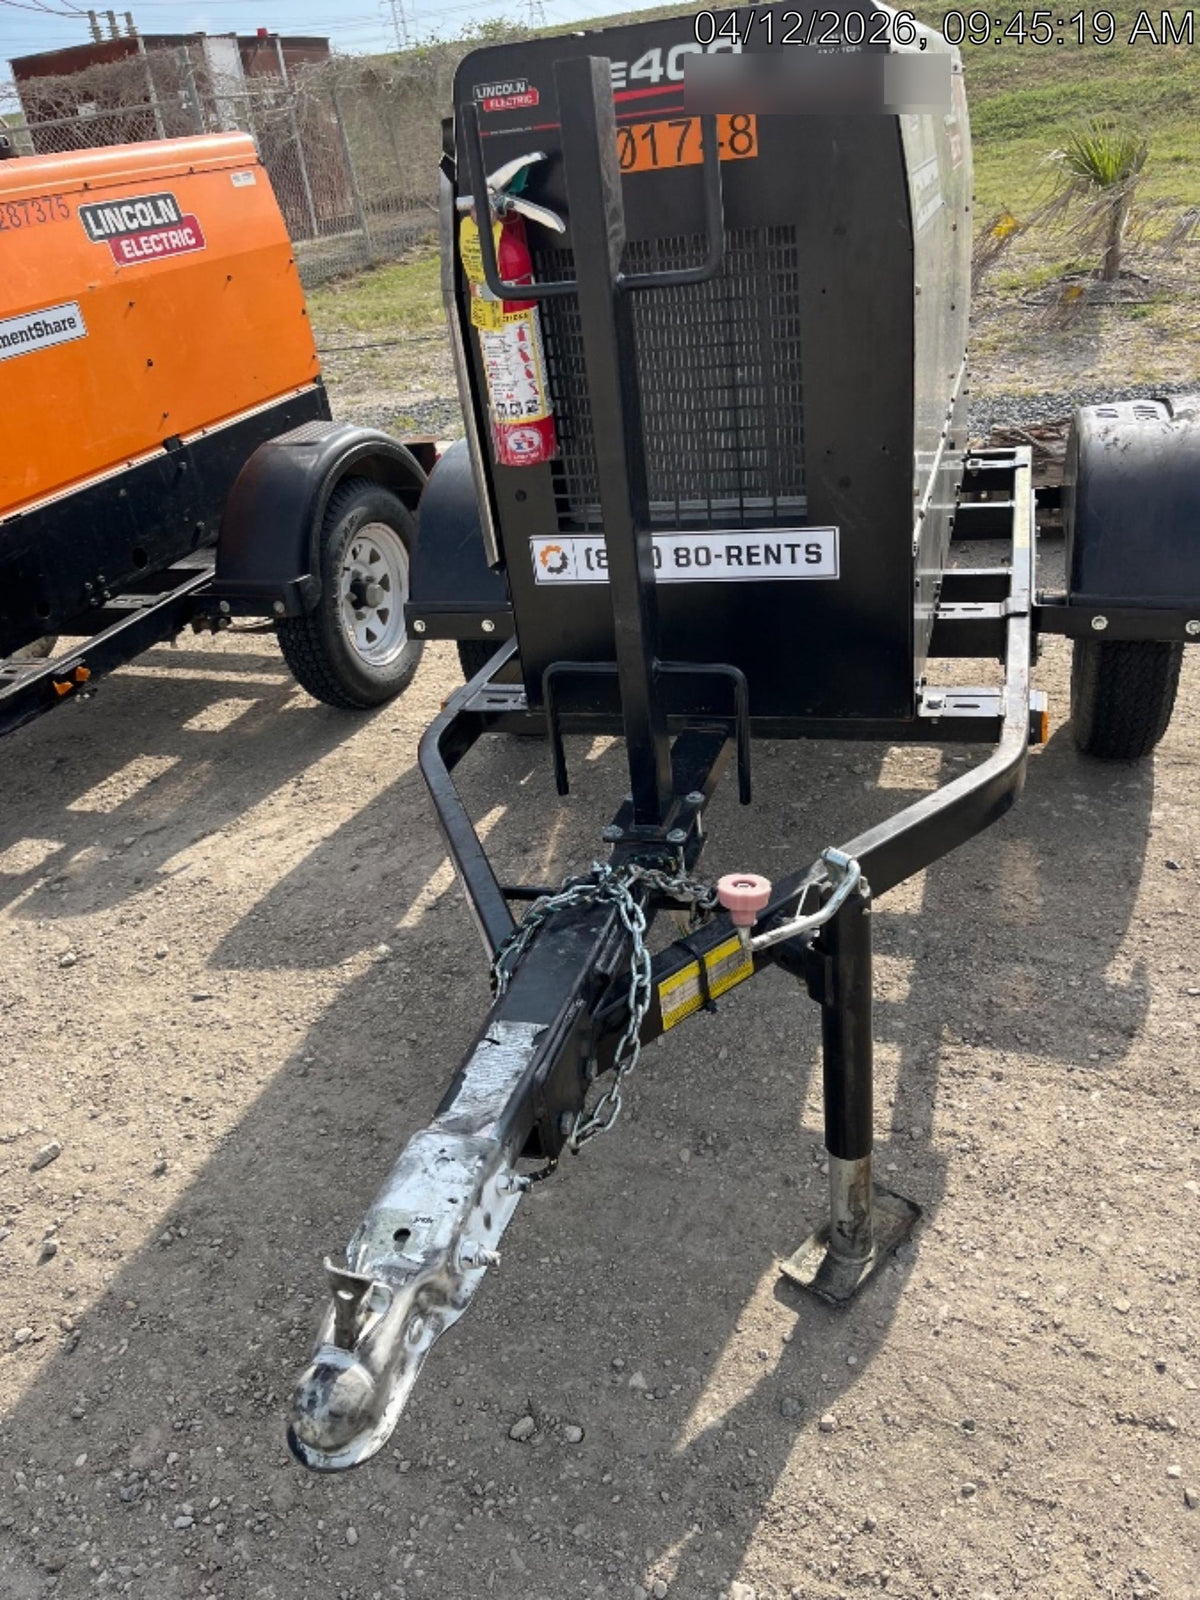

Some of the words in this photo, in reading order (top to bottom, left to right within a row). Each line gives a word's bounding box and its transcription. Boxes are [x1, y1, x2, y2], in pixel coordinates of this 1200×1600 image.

[476, 82, 526, 98] LINCOLN
[490, 95, 533, 108] ELECTRIC
[617, 114, 753, 169] 0178
[84, 199, 178, 236] LINCOLN
[120, 228, 196, 258] ELECTRIC
[585, 546, 662, 570] (8)
[674, 543, 822, 568] 80-RENTS
